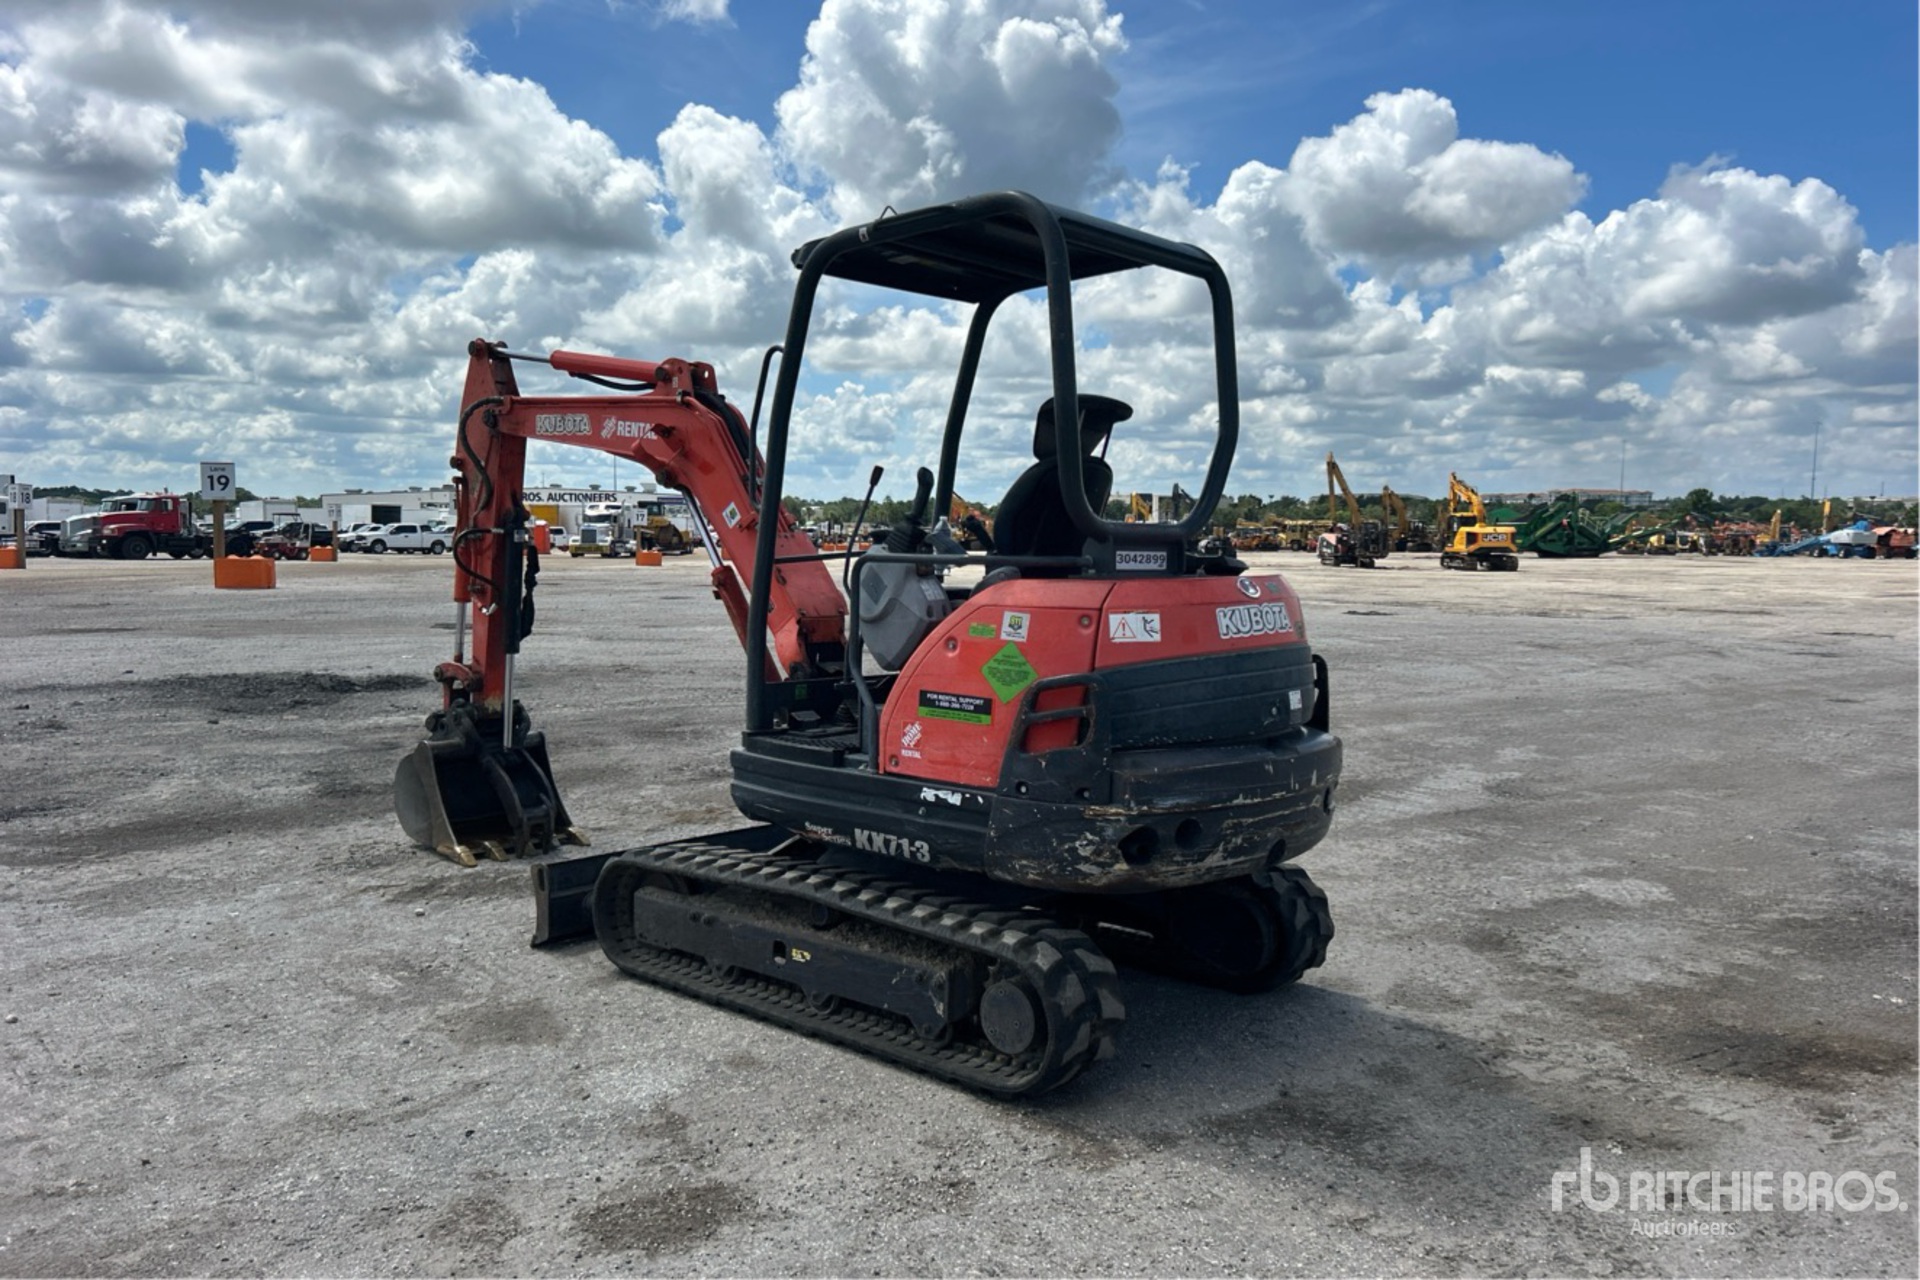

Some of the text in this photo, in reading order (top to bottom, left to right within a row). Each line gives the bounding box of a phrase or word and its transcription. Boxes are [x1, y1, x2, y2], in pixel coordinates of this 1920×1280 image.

[536, 413, 592, 435] KUBOTA
[207, 475, 230, 491] 19
[20, 492, 31, 504] 18
[547, 492, 617, 503] AUCTIONEERS
[635, 513, 645, 521] 17
[1483, 533, 1508, 542] JCB
[1116, 553, 1166, 564] 3042899
[1216, 603, 1293, 639] KUBOTA
[938, 694, 957, 702] RENTAL
[958, 696, 984, 706] SUPPORT
[805, 821, 833, 835] Super
[854, 828, 931, 862] KX71-3
